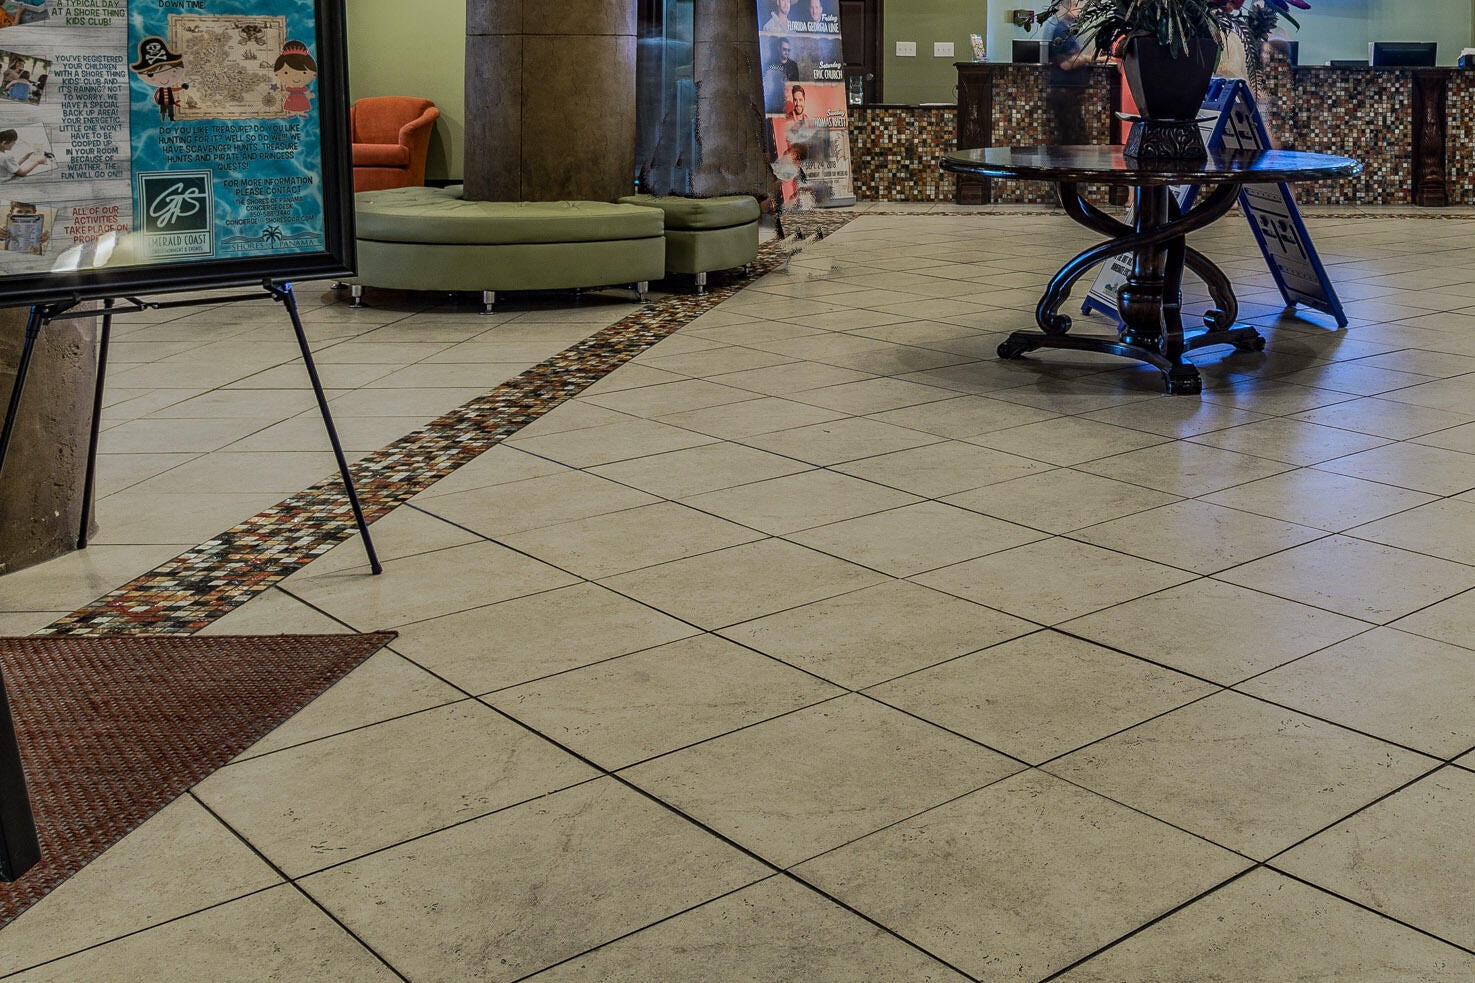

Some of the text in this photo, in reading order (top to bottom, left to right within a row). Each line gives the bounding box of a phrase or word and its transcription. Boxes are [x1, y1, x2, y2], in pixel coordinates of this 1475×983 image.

[65, 0, 100, 7] TYPICAL
[158, 0, 184, 8] DOWN
[52, 7, 62, 15] AT
[74, 8, 99, 16] SHORE
[102, 9, 125, 17] THING
[66, 17, 110, 25] KIDS CLUB!
[787, 20, 839, 33] FLORIDA GEORGIA LINE
[819, 61, 841, 69] Saturday
[814, 70, 842, 80] ERIC CHURCH
[223, 176, 312, 187] FOR MORE INFORMATION
[236, 186, 301, 196] PLEASE CONTACT
[72, 206, 118, 216] ALL OF OUR
[74, 214, 117, 226] ACTIVITIES
[63, 222, 127, 235] TAKE PLACE ON
[185, 234, 206, 244] COAST
[279, 239, 313, 247] PANAMA
